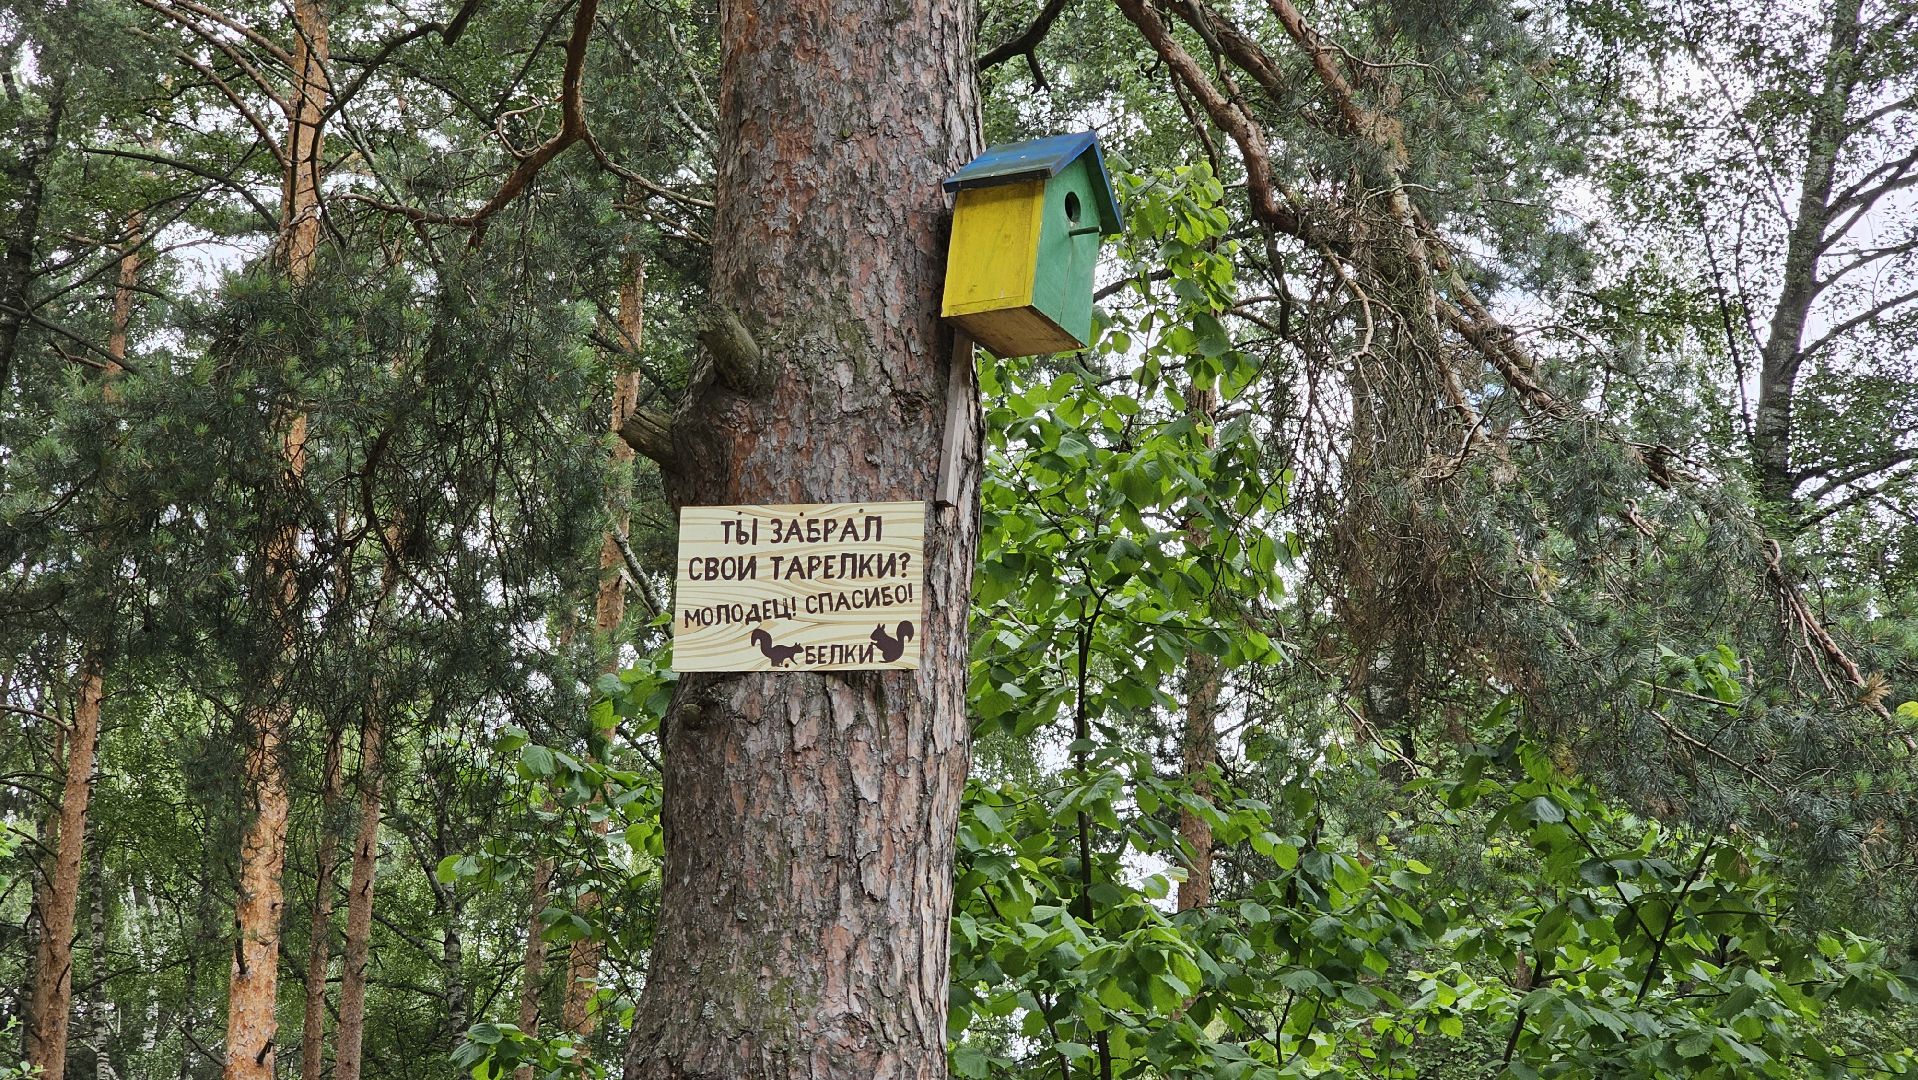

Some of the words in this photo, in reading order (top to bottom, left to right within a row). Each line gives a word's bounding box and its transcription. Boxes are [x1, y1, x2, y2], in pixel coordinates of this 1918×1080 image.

[720, 518, 758, 545] ТЫ
[770, 515, 882, 544] ЗАБРАЛ
[688, 556, 757, 581] СВОИ
[770, 552, 911, 580] ТАРЕЛКИ?
[684, 597, 797, 628] МОЛОДЕЦ!
[805, 583, 913, 614] СПАСИБО!
[805, 644, 874, 665] БЕЛКИ
